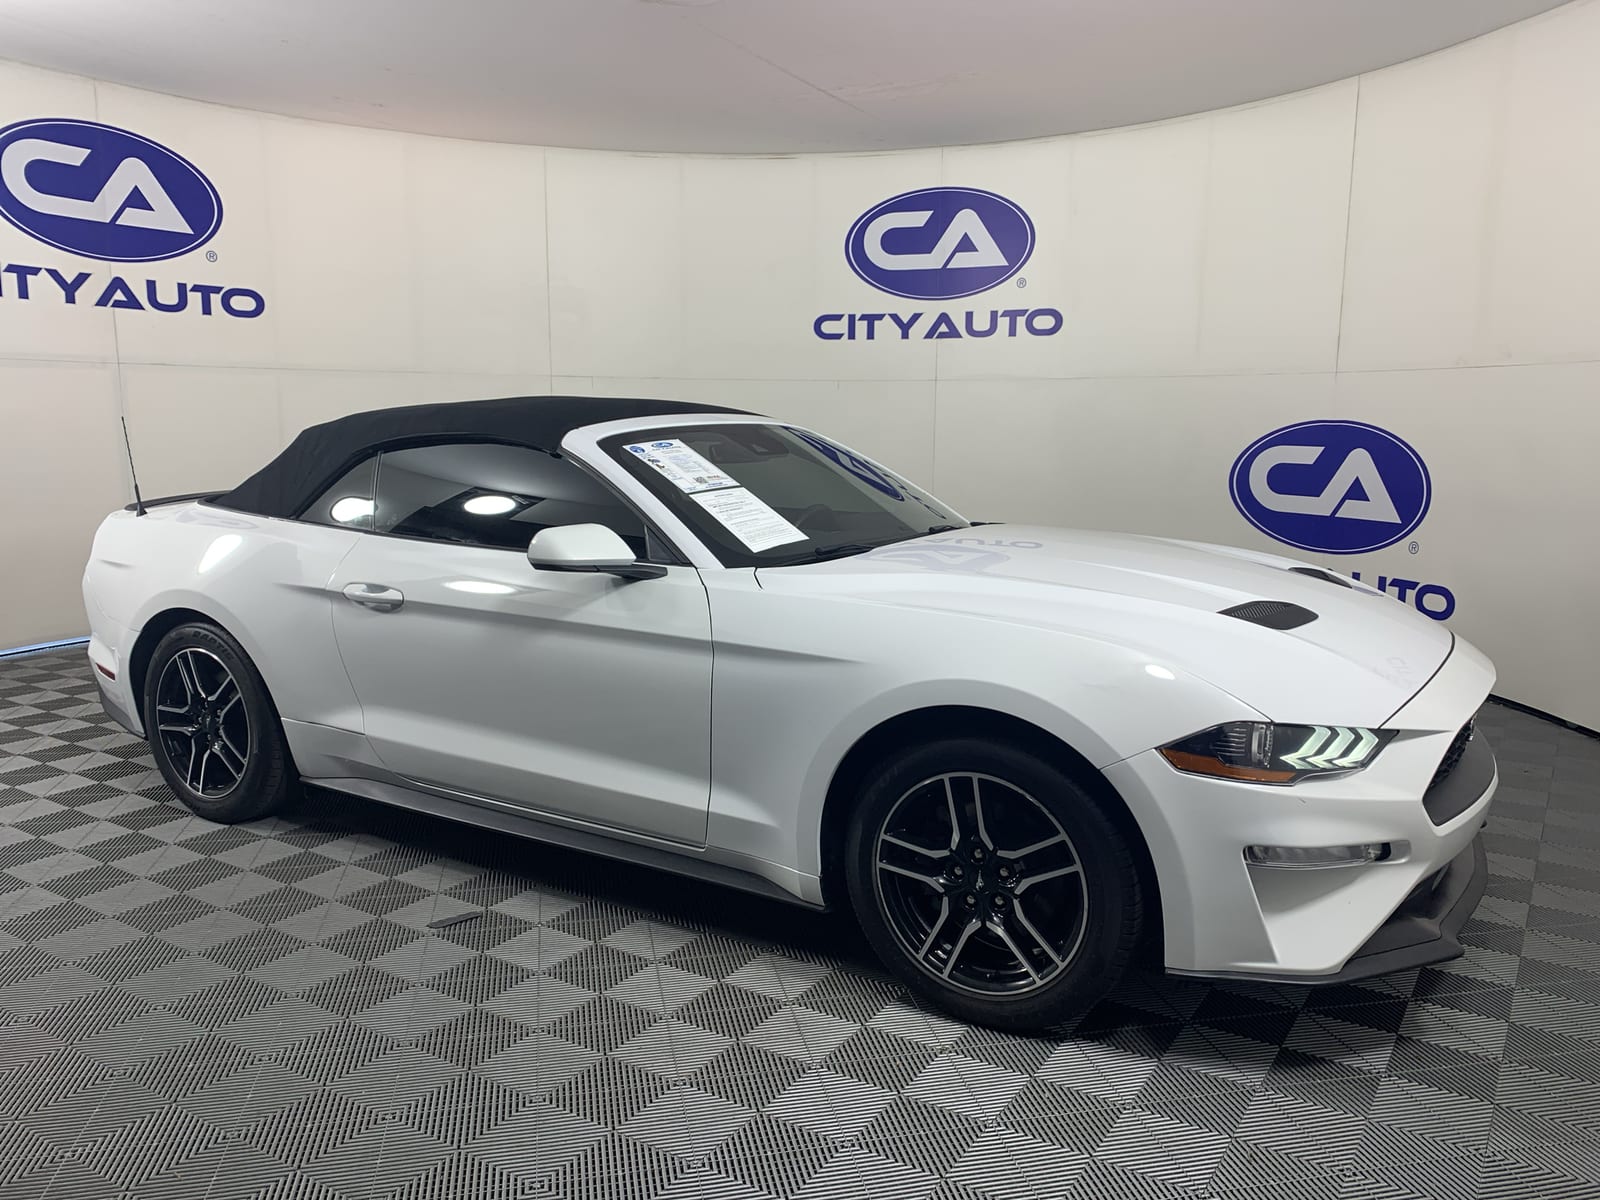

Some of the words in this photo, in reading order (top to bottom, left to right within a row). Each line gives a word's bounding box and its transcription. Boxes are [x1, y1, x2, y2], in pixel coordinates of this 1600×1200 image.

[1, 138, 195, 235] CA
[863, 208, 1010, 271] CA
[1249, 444, 1402, 524] CA
